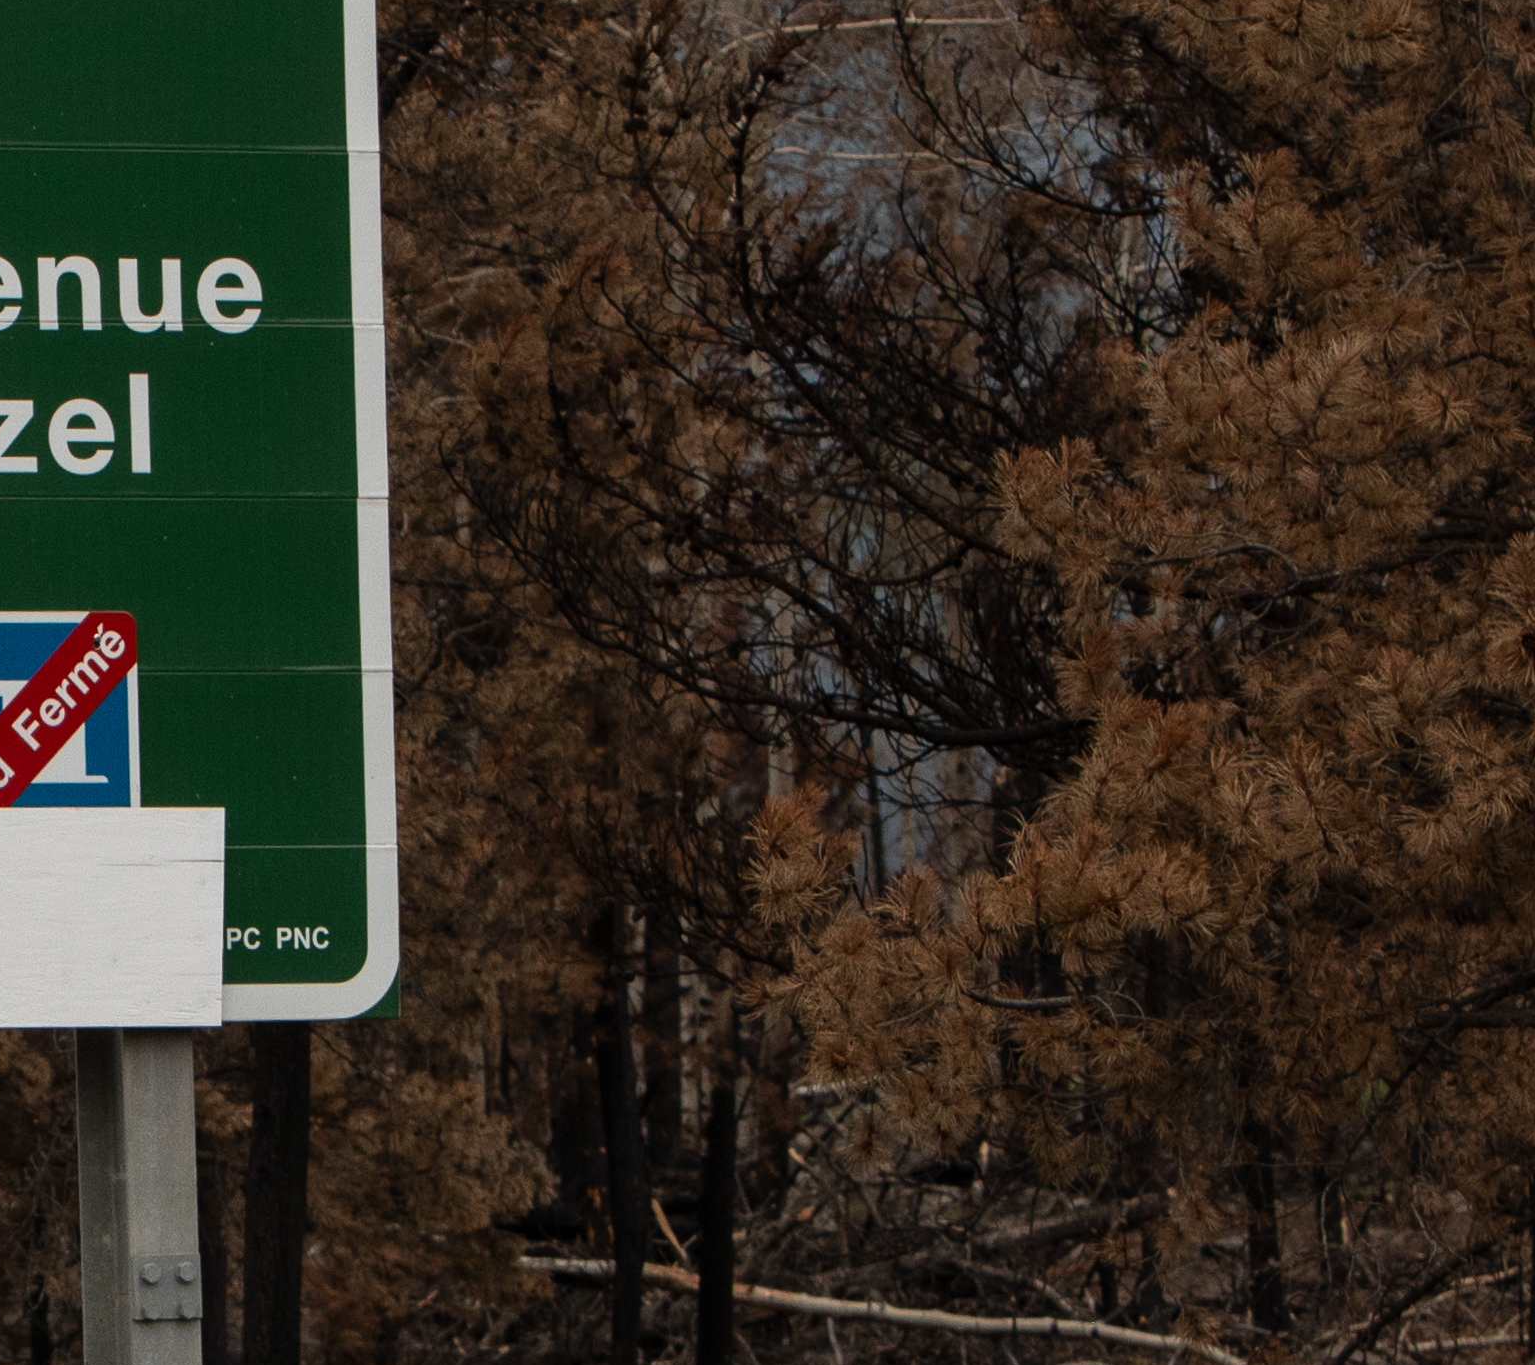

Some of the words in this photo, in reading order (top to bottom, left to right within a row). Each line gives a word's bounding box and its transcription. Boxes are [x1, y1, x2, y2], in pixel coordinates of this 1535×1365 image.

[11, 622, 126, 752] Fermé
[226, 926, 261, 951] PC
[276, 925, 330, 951] PNC
